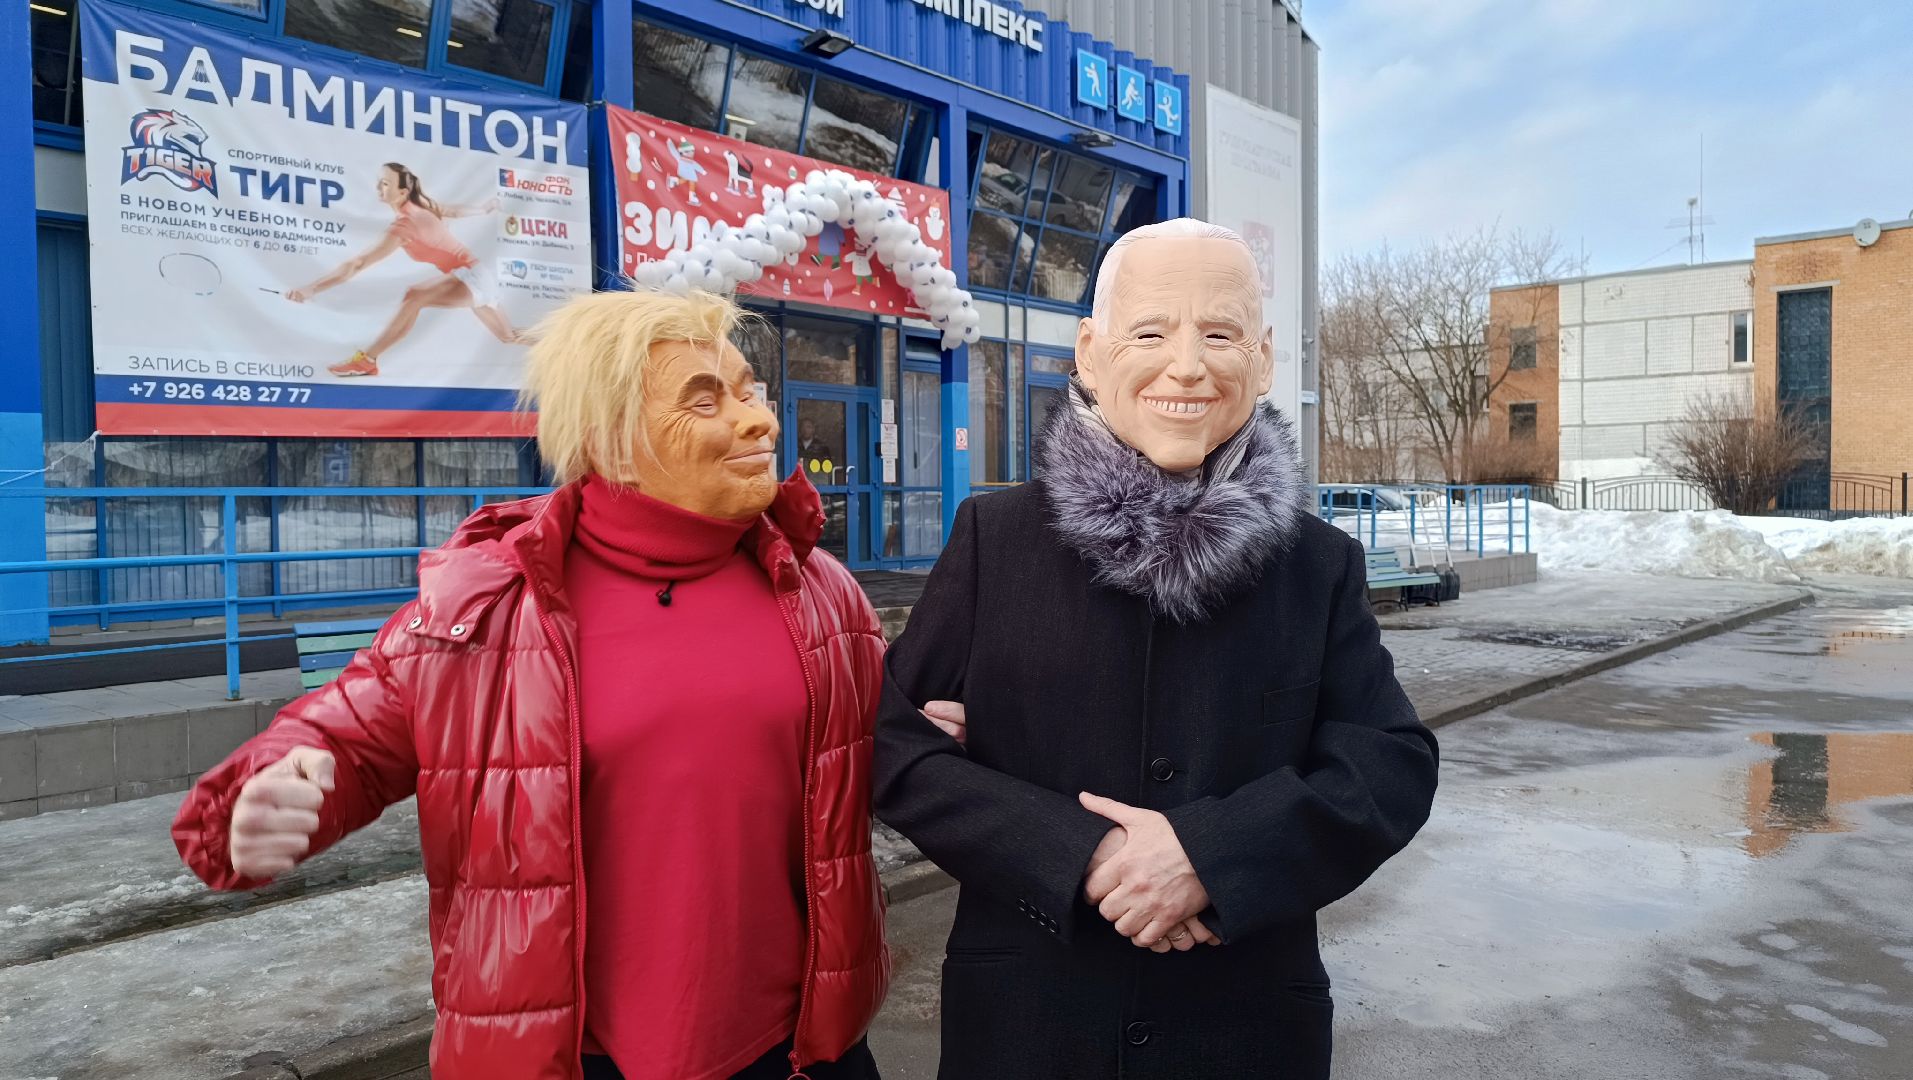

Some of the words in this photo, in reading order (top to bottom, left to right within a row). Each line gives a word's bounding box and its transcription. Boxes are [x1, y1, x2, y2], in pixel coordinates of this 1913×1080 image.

[912, 0, 1043, 52] ПЛЕКС
[115, 30, 569, 166] БАДМИНТОН
[125, 146, 213, 189] TIGER
[228, 149, 311, 170] СПОРТИВНЫЙ
[315, 163, 345, 175] КЛУБ
[230, 166, 345, 208] ТИГР
[517, 179, 573, 196] ЮНОСТЬ
[120, 194, 131, 205] В
[139, 197, 206, 216] НОВОМ
[212, 207, 297, 227] УЧЕБНОМ
[303, 219, 347, 234] ГОДУ
[120, 211, 207, 230] ПРИГЛАШАЕМ
[210, 223, 217, 231] В
[220, 224, 270, 238] СЕКЦИЮ
[274, 230, 347, 247] БАДМИНТОНА
[521, 217, 568, 239] ЦСКА
[122, 224, 153, 237] ВСЕХ
[157, 228, 231, 246] ЖЕЛАЮЩИХ
[234, 238, 250, 248] ОТ
[254, 241, 260, 249] 6
[263, 242, 280, 252] ДО
[284, 244, 296, 253] 65
[299, 245, 319, 255] ЛЕТ
[128, 356, 210, 373] ЗАПИСЬ
[217, 361, 228, 374] В
[234, 362, 314, 379] СЕКЦИЮ
[128, 382, 157, 398] +7
[164, 382, 205, 400] 926
[212, 385, 252, 401] 428
[258, 387, 282, 402] 27
[288, 388, 312, 403] 77
